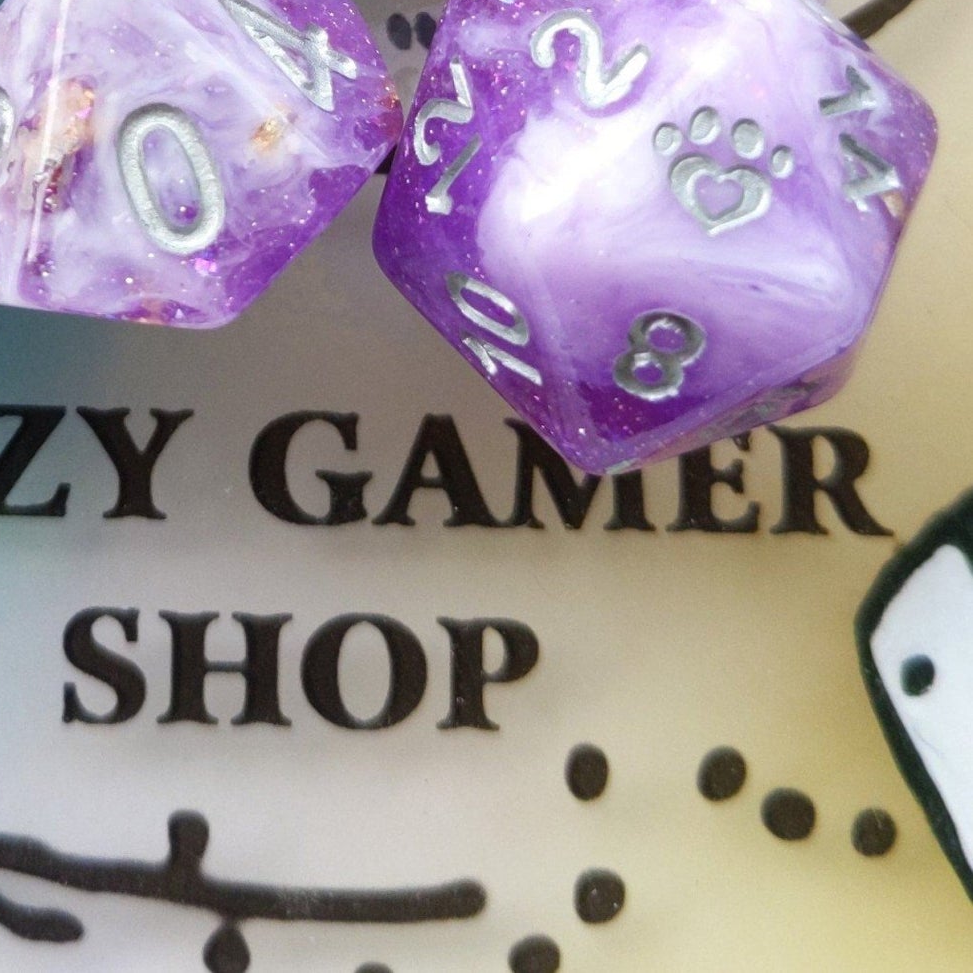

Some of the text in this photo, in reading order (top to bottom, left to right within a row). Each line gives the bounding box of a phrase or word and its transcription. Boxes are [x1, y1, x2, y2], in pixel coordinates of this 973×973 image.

[530, 7, 650, 109] 2
[115, 101, 226, 255] 0
[612, 309, 707, 402] 8
[62, 606, 540, 730] SHOP
